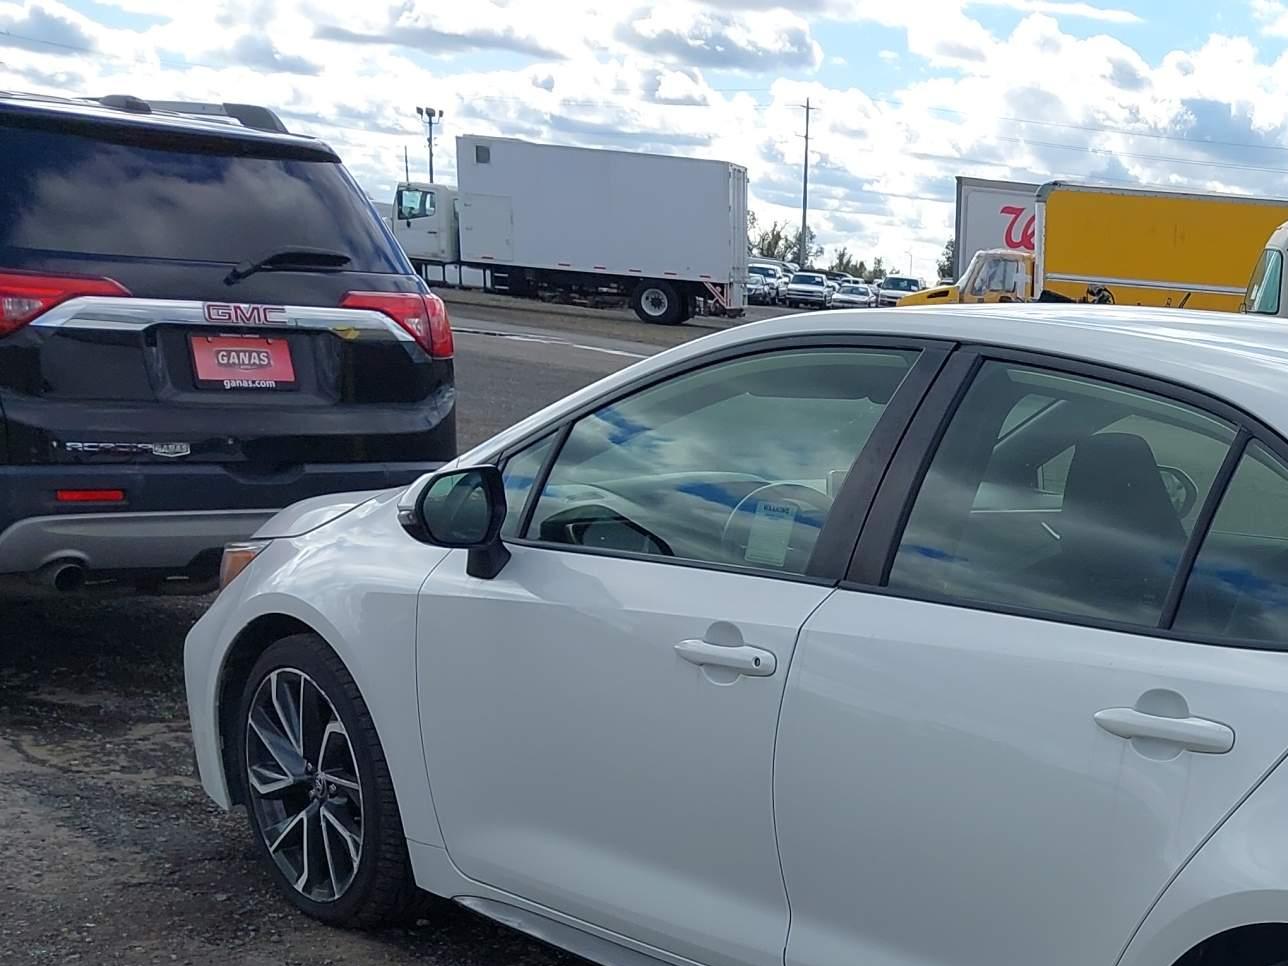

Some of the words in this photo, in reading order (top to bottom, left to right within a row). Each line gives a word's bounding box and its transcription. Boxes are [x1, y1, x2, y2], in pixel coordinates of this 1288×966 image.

[204, 303, 288, 326] GMC
[217, 351, 270, 366] GANAS
[223, 379, 276, 390] ganas.com
